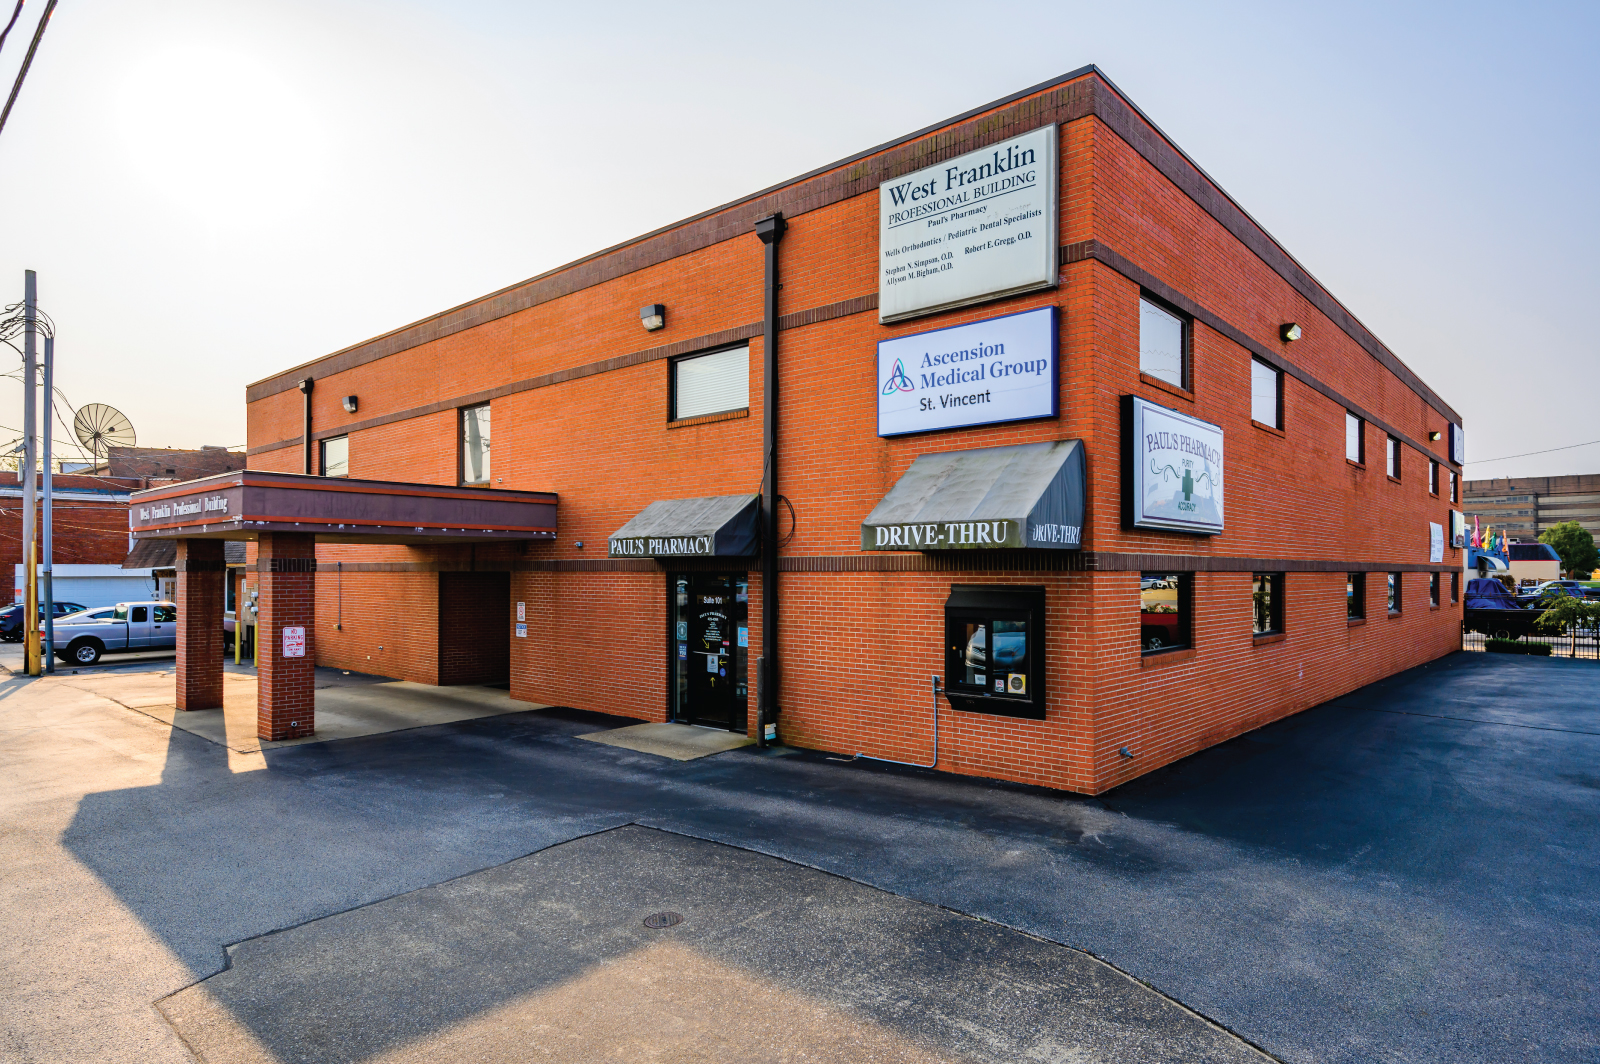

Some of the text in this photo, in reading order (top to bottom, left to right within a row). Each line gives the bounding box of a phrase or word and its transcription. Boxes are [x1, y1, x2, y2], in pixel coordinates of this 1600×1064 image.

[889, 145, 1036, 207] West Franklin
[888, 192, 970, 225] PROFESSIONAL
[974, 170, 1036, 199] BUILDING
[927, 216, 948, 228] Paul's
[950, 205, 988, 221] Pharmacy
[885, 248, 900, 258] Wells
[901, 236, 942, 253] Orthodontics
[948, 227, 977, 241] Pediatric
[980, 219, 1001, 232] Dental
[1004, 209, 1042, 226] Specialists
[964, 231, 1032, 255] Robert E. Gregg, O.D.
[885, 265, 906, 276] Stephen
[914, 256, 940, 268] Simpson,
[941, 252, 953, 261] O.D.
[886, 276, 906, 286] Allyson
[908, 271, 915, 280] M.
[940, 262, 953, 271] O.D.
[920, 342, 1005, 368] Ascension
[920, 358, 1047, 389] Medical Group
[919, 389, 991, 412] St. Vincent
[1146, 431, 1221, 469] PAUL'S PHARMACY
[1182, 459, 1194, 469] PURITY
[140, 496, 228, 521] West Franklin Professional Building
[1178, 501, 1196, 512] ACCURACY
[875, 521, 1008, 546] DRIVE-THRU
[1032, 523, 1082, 545] DRIVE-THRU
[611, 537, 712, 555] PAUL'S PHARMACY
[703, 596, 723, 605] Suite 101
